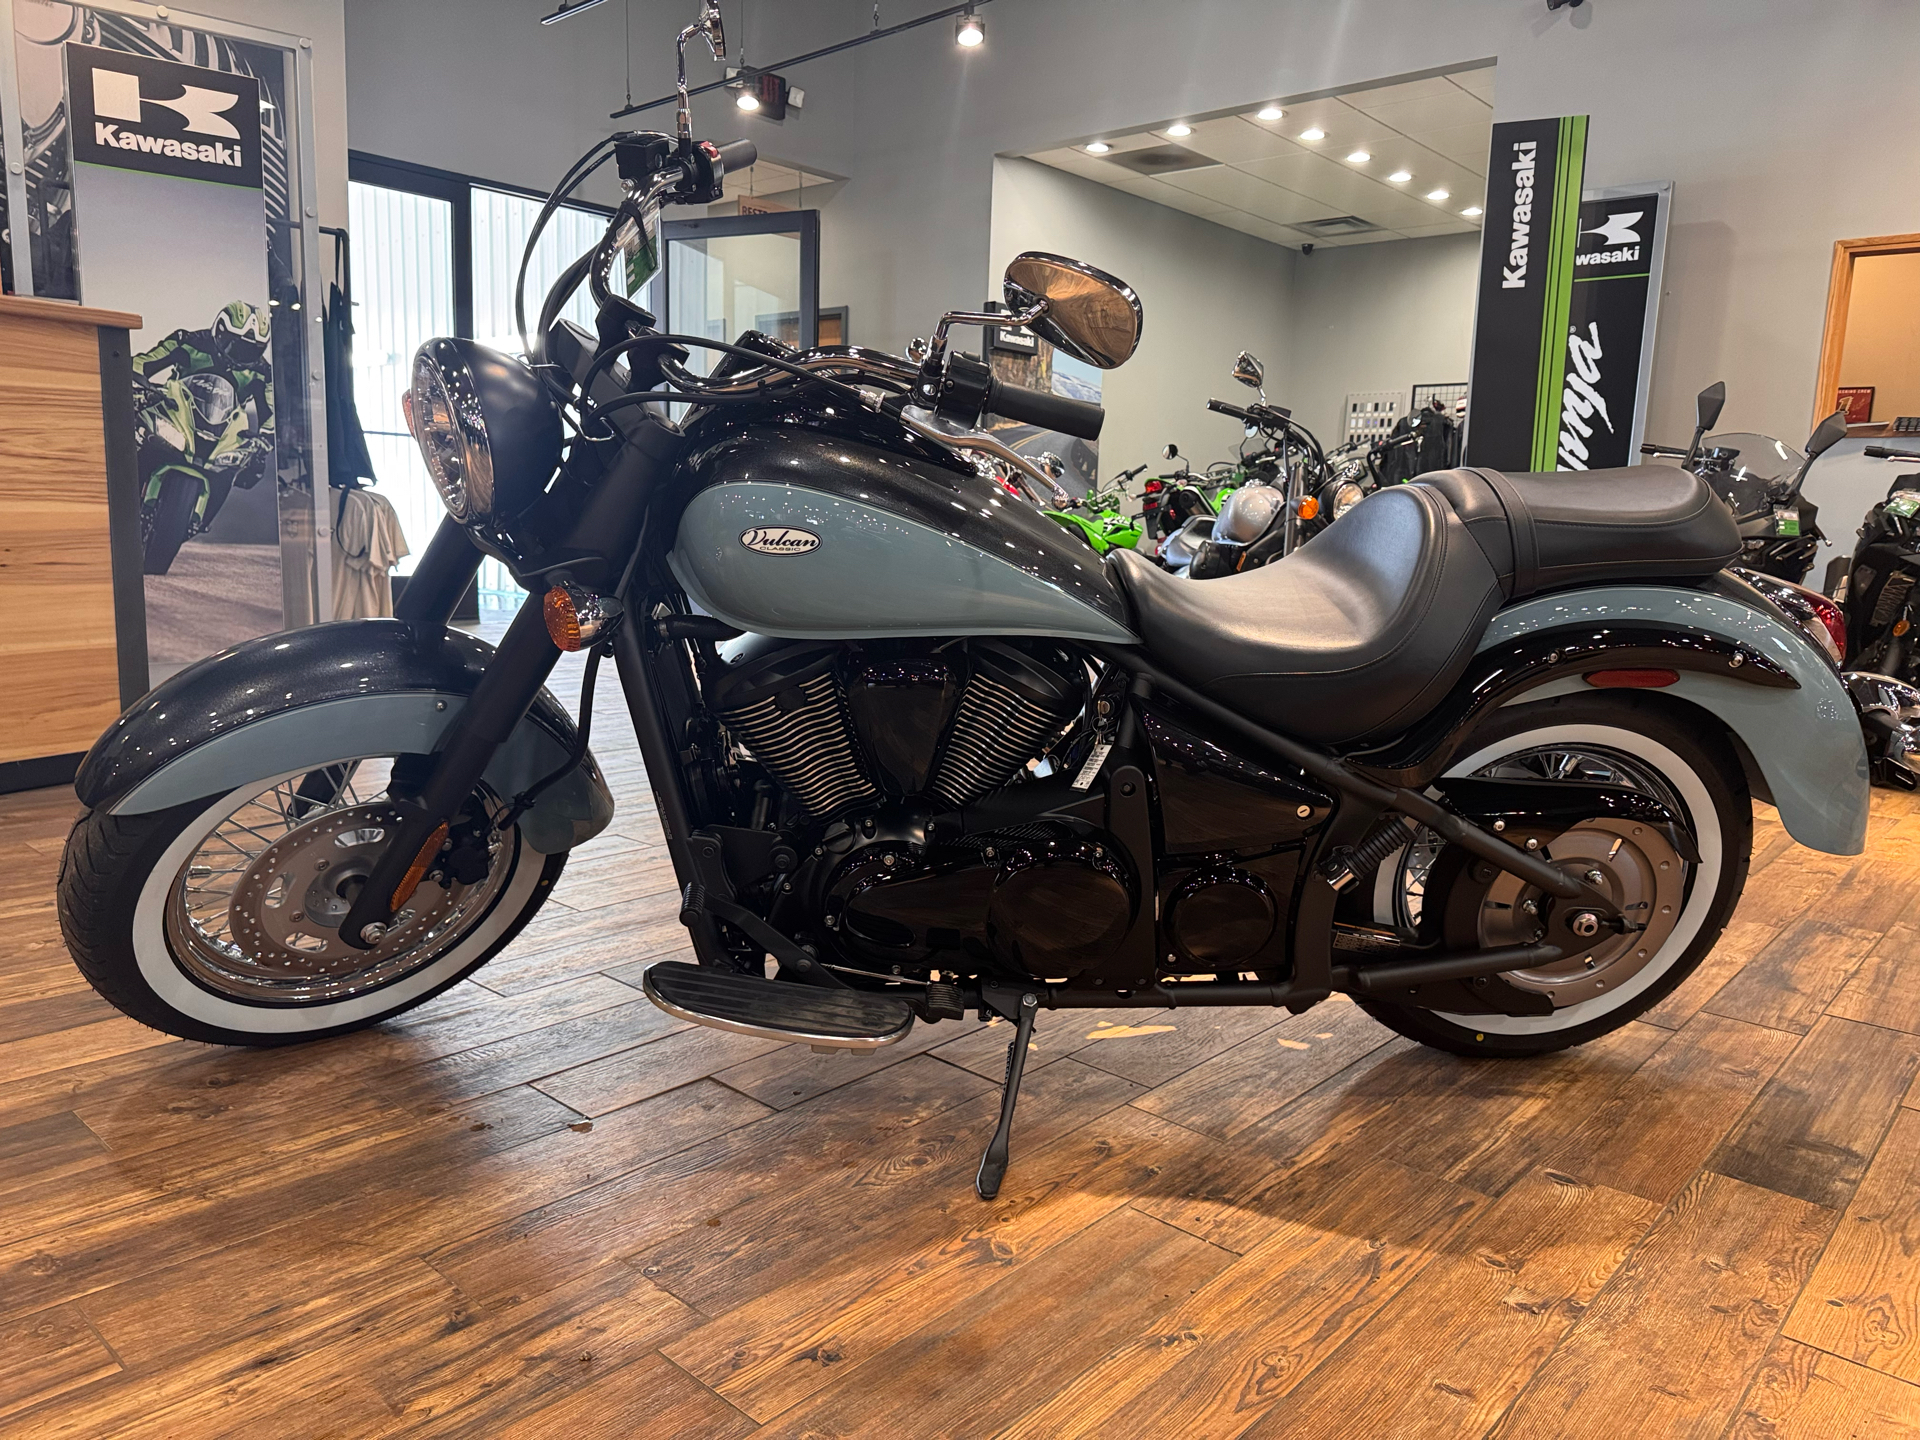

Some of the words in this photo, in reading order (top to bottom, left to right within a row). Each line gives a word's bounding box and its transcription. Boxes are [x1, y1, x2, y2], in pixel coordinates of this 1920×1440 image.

[95, 122, 242, 167] Kawasaki
[1502, 141, 1537, 289] Kawasaki
[1575, 245, 1640, 266] wasaki
[1000, 330, 1034, 347] Kawasaki
[1557, 321, 1614, 471] inja
[746, 530, 817, 546] Vulcan
